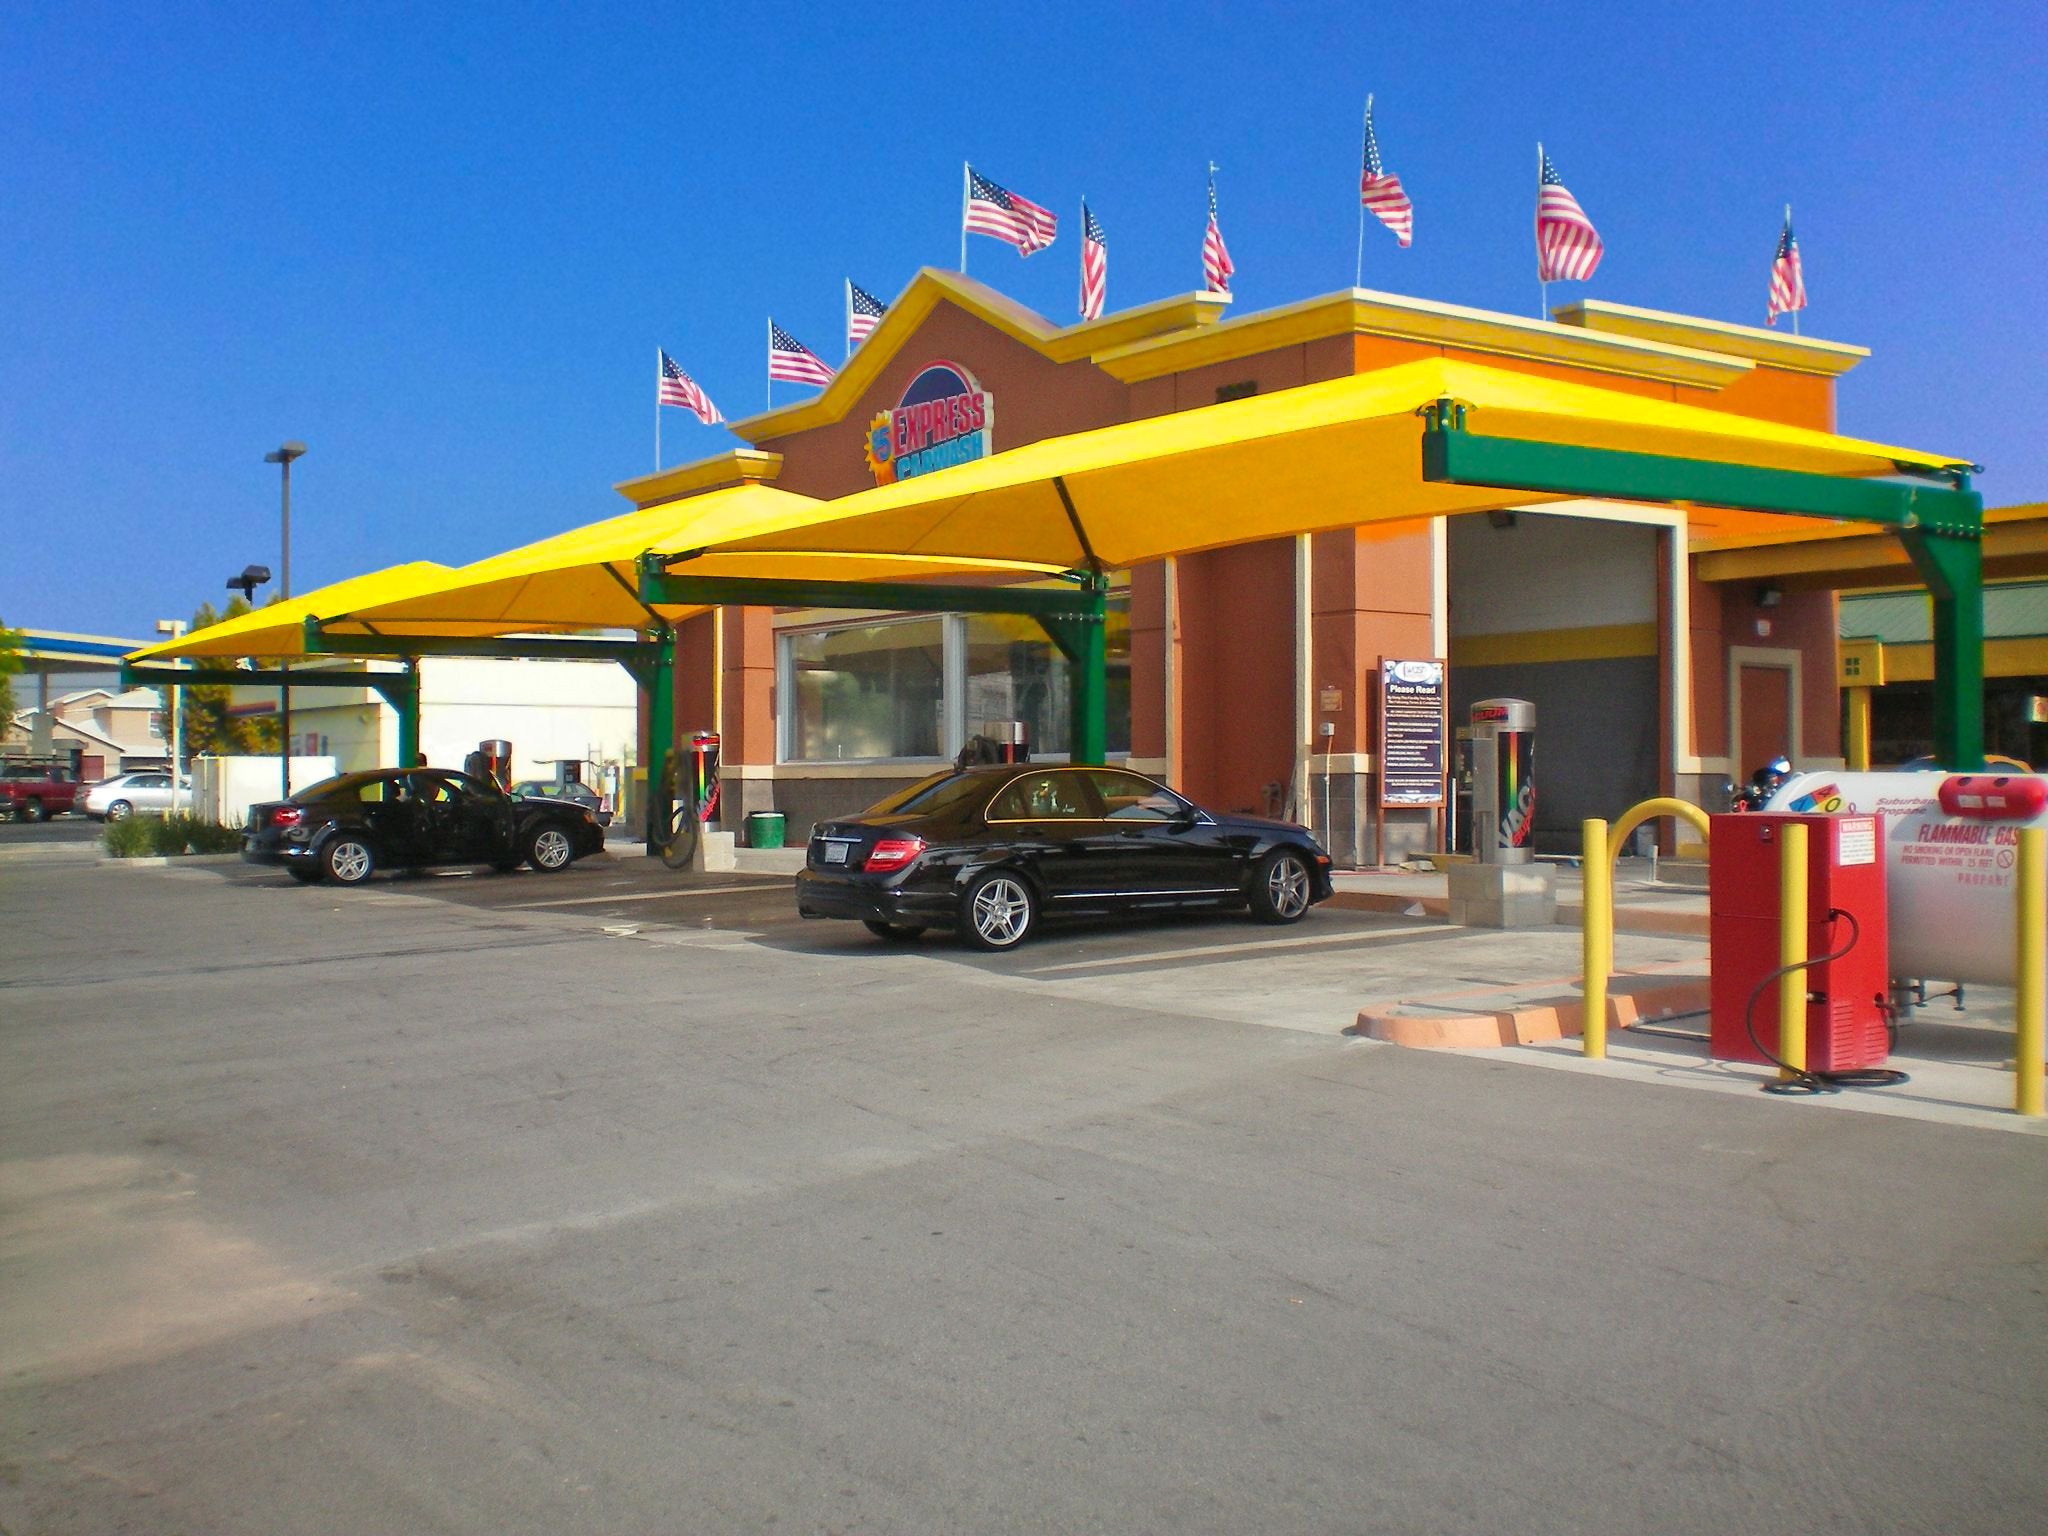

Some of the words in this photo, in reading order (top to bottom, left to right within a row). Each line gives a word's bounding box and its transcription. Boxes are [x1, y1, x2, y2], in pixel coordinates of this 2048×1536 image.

[892, 393, 985, 457] EXPRESS
[1390, 684, 1415, 694] Please
[1415, 685, 1436, 694] Read
[1876, 797, 1936, 806] Suburban
[1876, 806, 1927, 816] Propane
[1918, 823, 1994, 845] FLAMMABLE
[1995, 826, 2018, 846] GAS
[1903, 845, 1913, 854] NO
[1914, 846, 1943, 855] SMOKING
[1944, 847, 1955, 855] OR
[1956, 847, 1972, 856] OPEN
[1974, 848, 1995, 857] FLAME
[1901, 855, 1937, 865] PERMITTED
[1938, 857, 1963, 867] WITHIN
[1958, 872, 2010, 887] PROPANE
